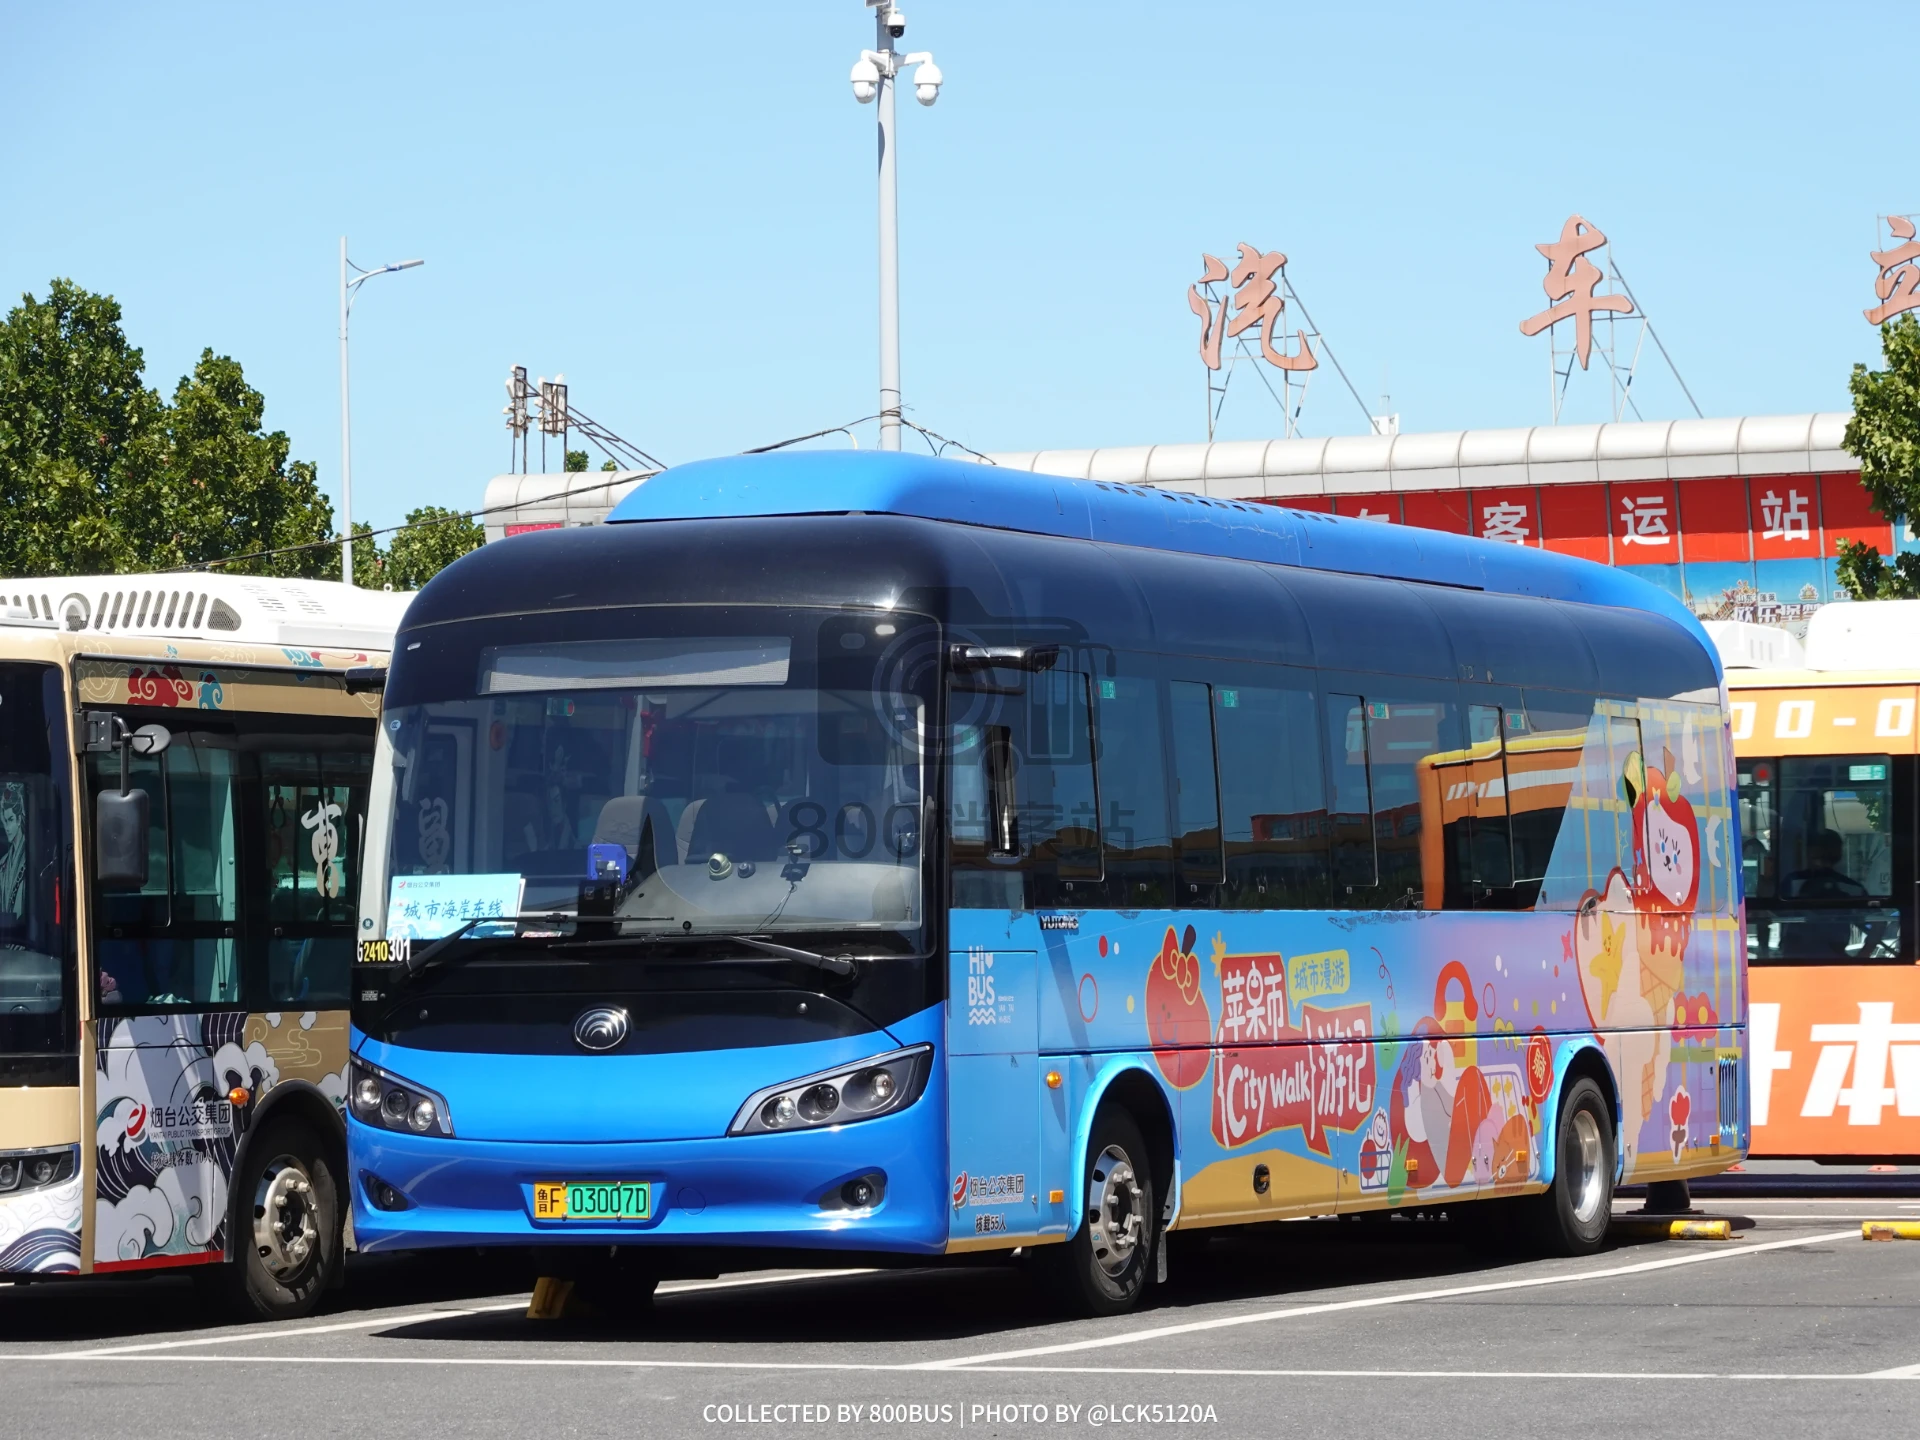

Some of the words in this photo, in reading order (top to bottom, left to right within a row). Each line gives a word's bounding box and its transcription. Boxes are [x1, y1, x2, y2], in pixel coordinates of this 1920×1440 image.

[403, 899, 504, 921] 城市海岸东线
[1041, 915, 1079, 930] YUTONG
[1294, 958, 1345, 992] 城市漫游
[968, 975, 996, 1007] BUS
[1223, 960, 1284, 1043] 苹果市
[1318, 1018, 1371, 1117] 游记
[150, 1103, 231, 1128] 烟台公交集团
[969, 1174, 1024, 1197] 烟台公交集团
